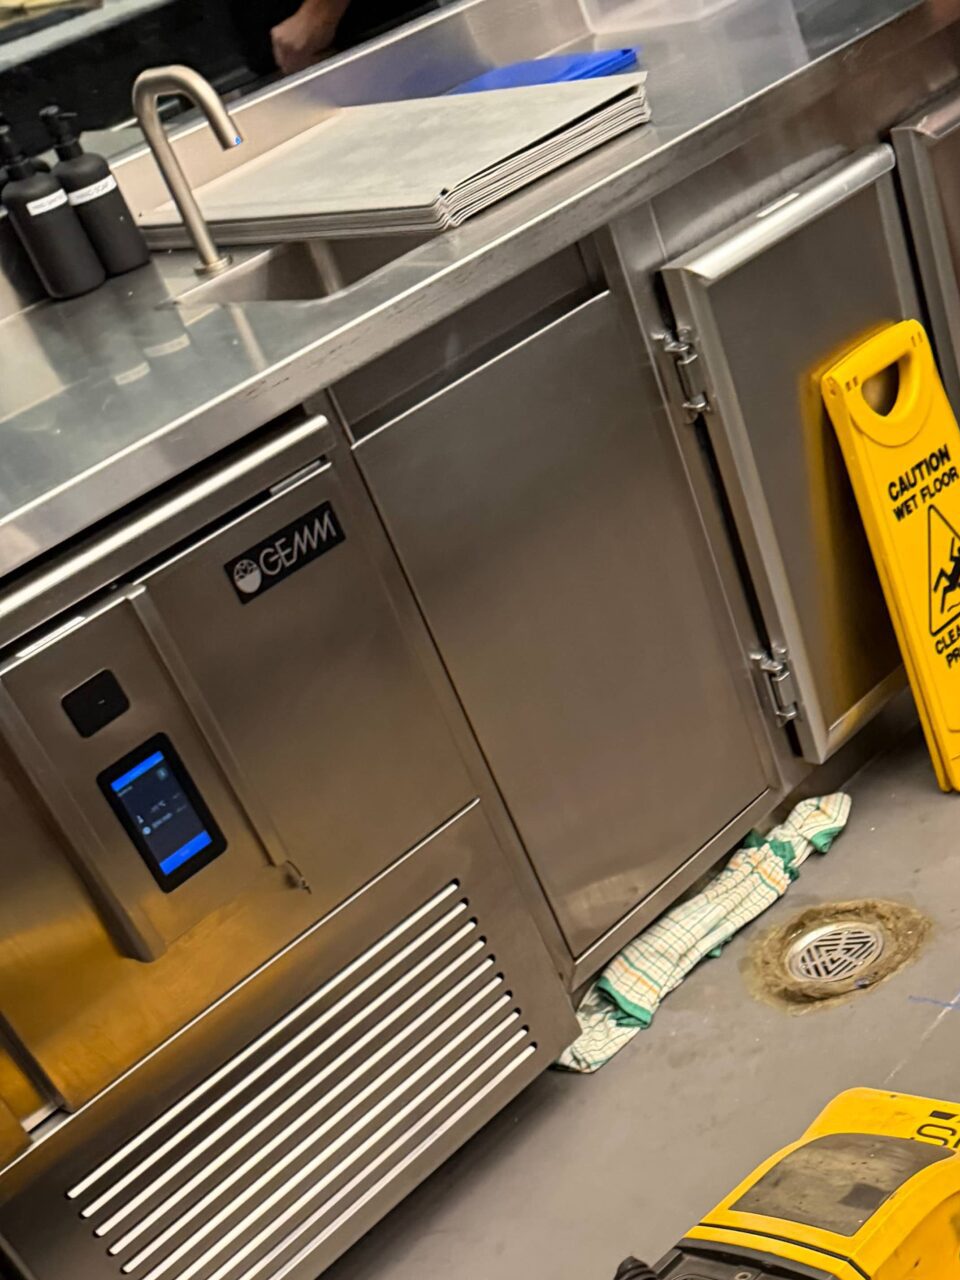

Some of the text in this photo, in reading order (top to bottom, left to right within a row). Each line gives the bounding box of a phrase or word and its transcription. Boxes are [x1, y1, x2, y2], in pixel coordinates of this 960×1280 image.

[888, 444, 951, 501] CAUTION
[893, 466, 960, 522] WET FLOOR
[260, 510, 337, 575] GEMM
